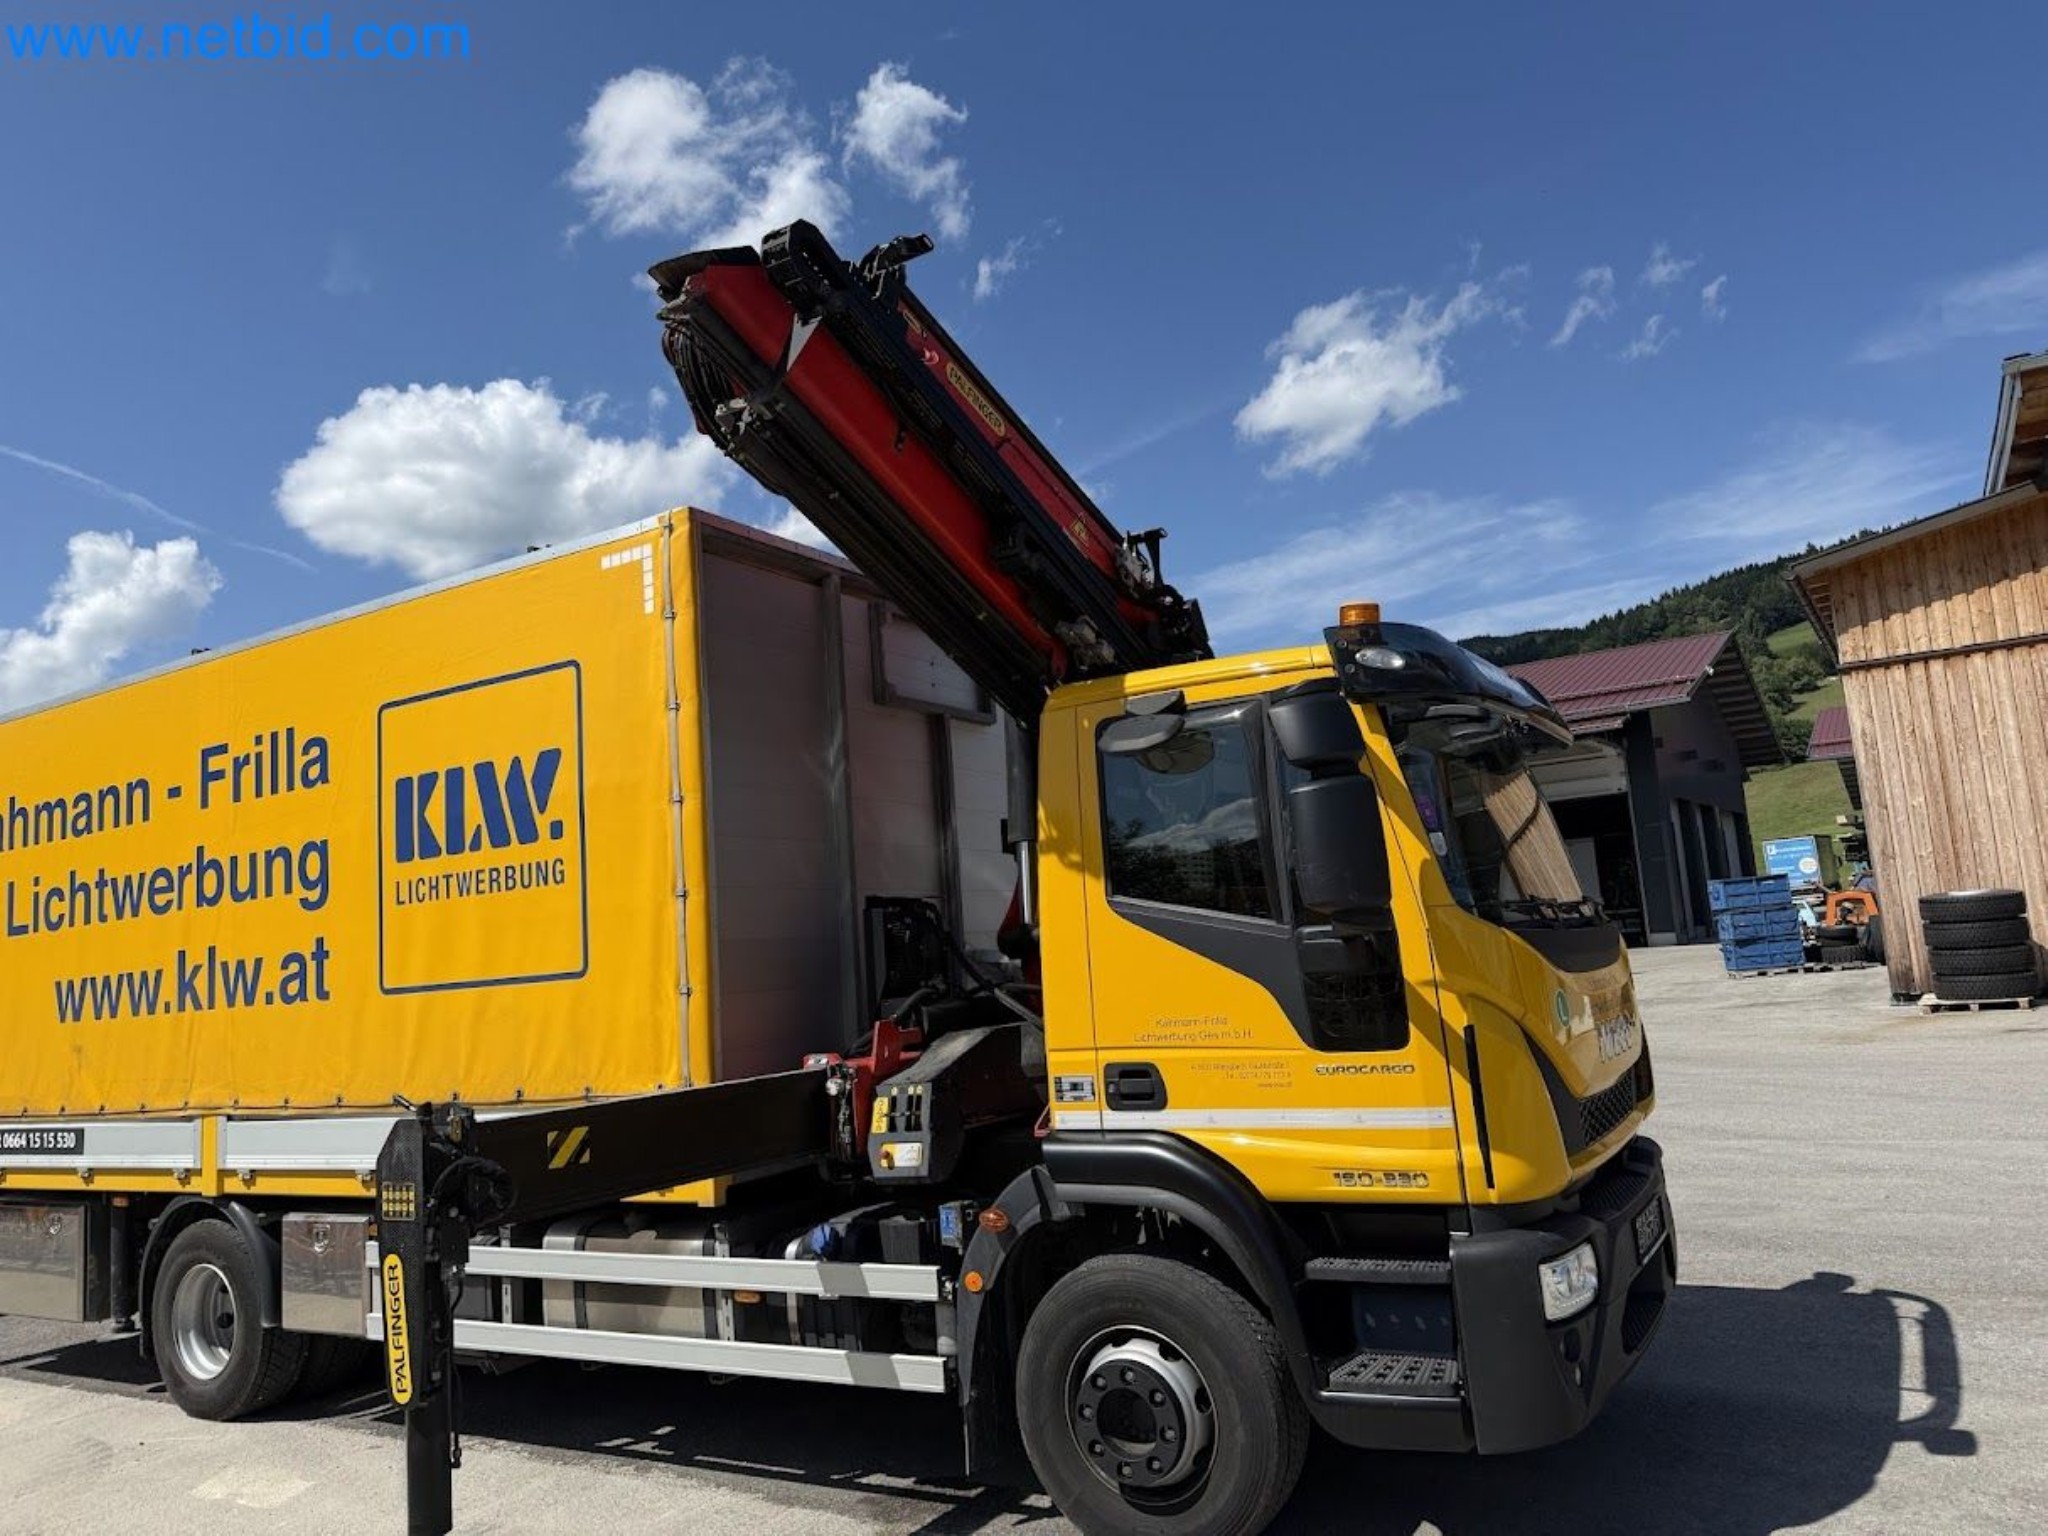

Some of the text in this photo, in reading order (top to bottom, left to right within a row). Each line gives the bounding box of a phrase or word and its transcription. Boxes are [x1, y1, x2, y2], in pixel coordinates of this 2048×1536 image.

[949, 366, 1003, 429] PALFINGER
[0, 777, 151, 853] hmann
[200, 726, 330, 810] Frilla
[7, 838, 330, 938] Lichtwerbung
[395, 857, 565, 906] LICHTWERBUNG
[54, 936, 331, 1024] www.klw.at
[1315, 1064, 1415, 1076] EUROCARGO
[3, 1131, 76, 1149] 0664 15 15 530
[386, 1263, 409, 1395] PALFINGER
